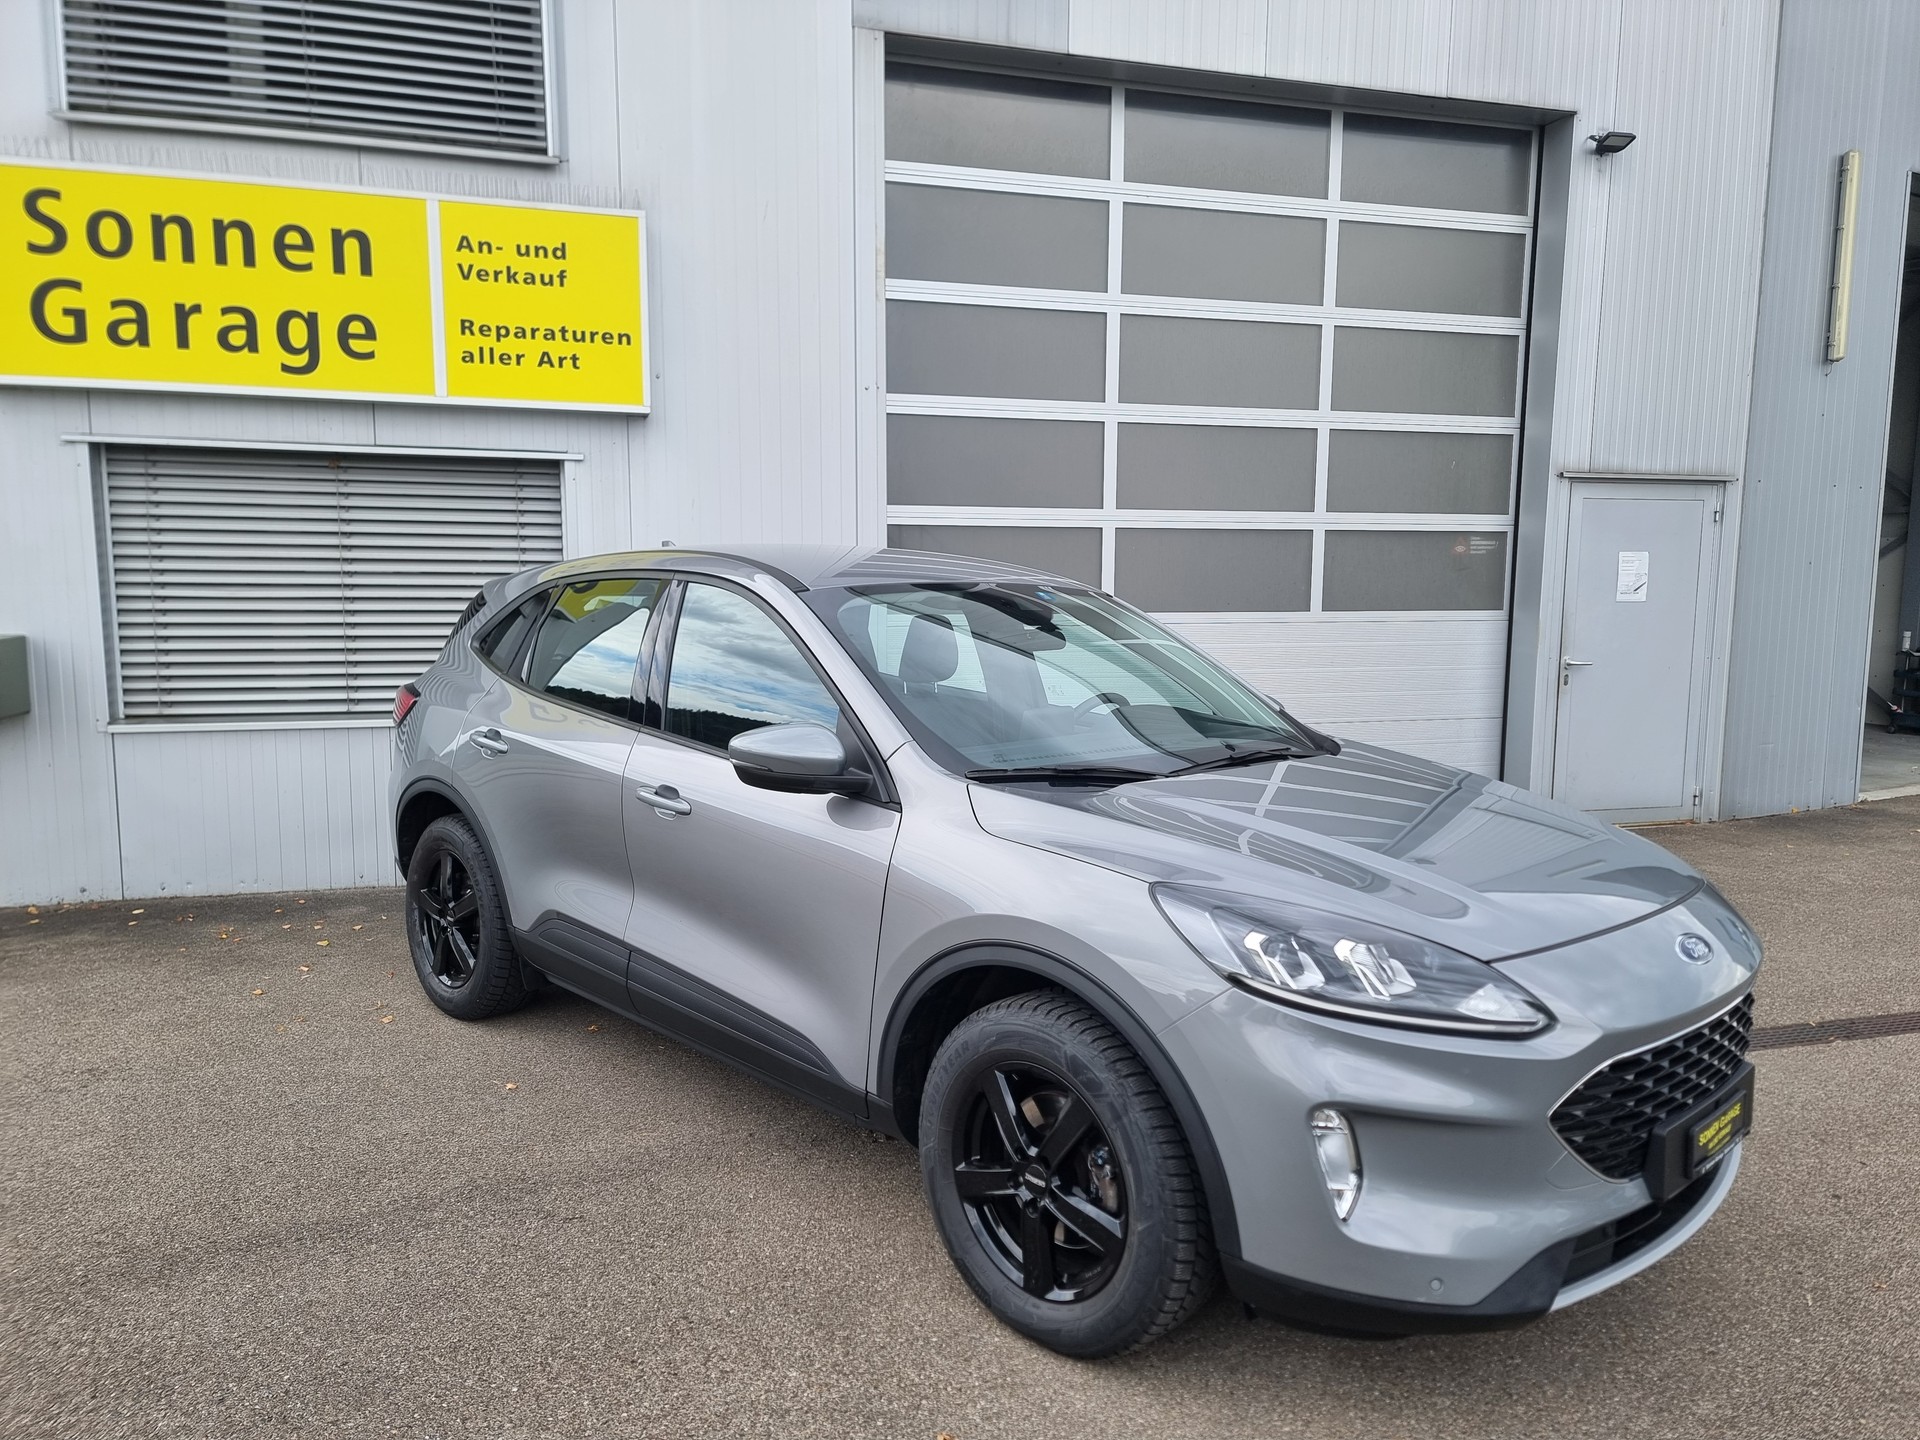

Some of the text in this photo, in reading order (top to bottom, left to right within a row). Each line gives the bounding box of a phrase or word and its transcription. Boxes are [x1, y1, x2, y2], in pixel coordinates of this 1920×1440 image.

[23, 188, 373, 277] Sonnen
[456, 235, 567, 261] An- und
[457, 263, 567, 288] Verkauf
[30, 278, 377, 376] Garage
[460, 318, 631, 346] Reparaturen
[461, 346, 580, 370] aller Art
[925, 1039, 970, 1126] ODYEAR
